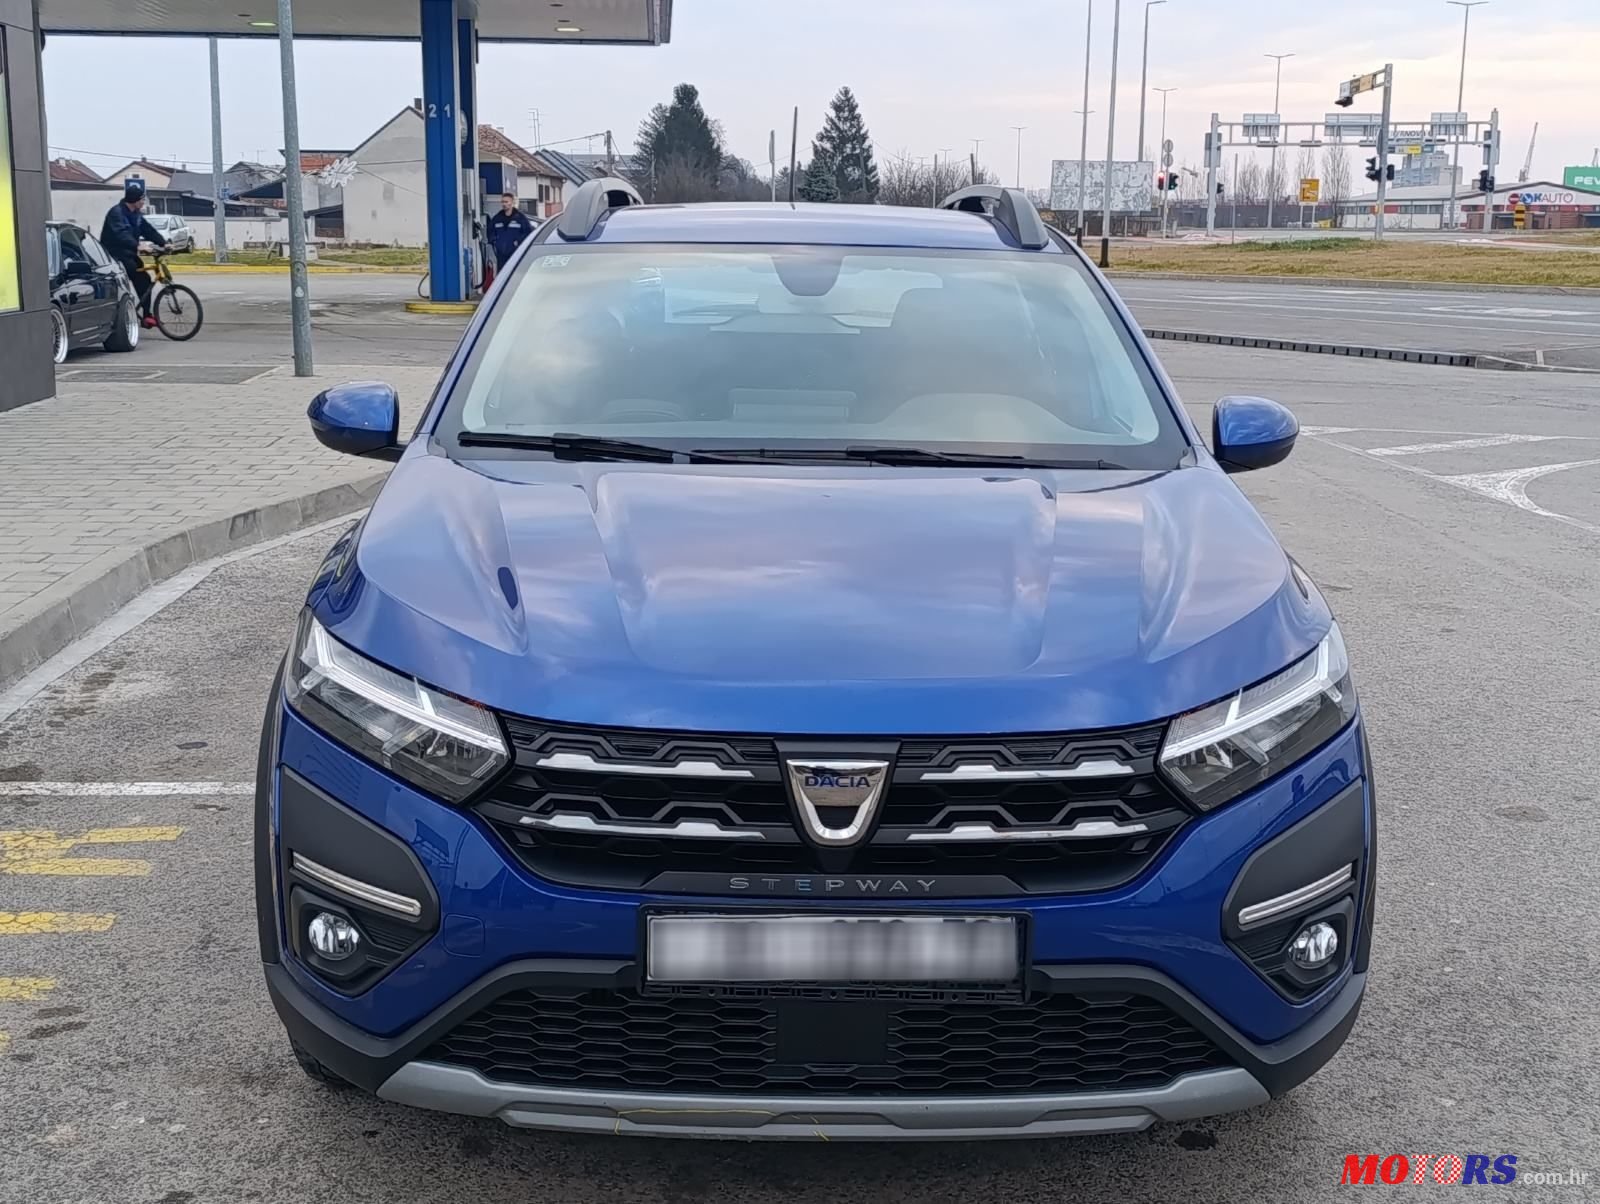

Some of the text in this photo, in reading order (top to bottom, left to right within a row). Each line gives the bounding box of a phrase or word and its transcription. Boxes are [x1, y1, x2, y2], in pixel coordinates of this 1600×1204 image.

[428, 103, 437, 118] 2
[444, 103, 451, 118] 1
[804, 775, 871, 788] DACIA
[729, 877, 936, 893] STEPWAY
